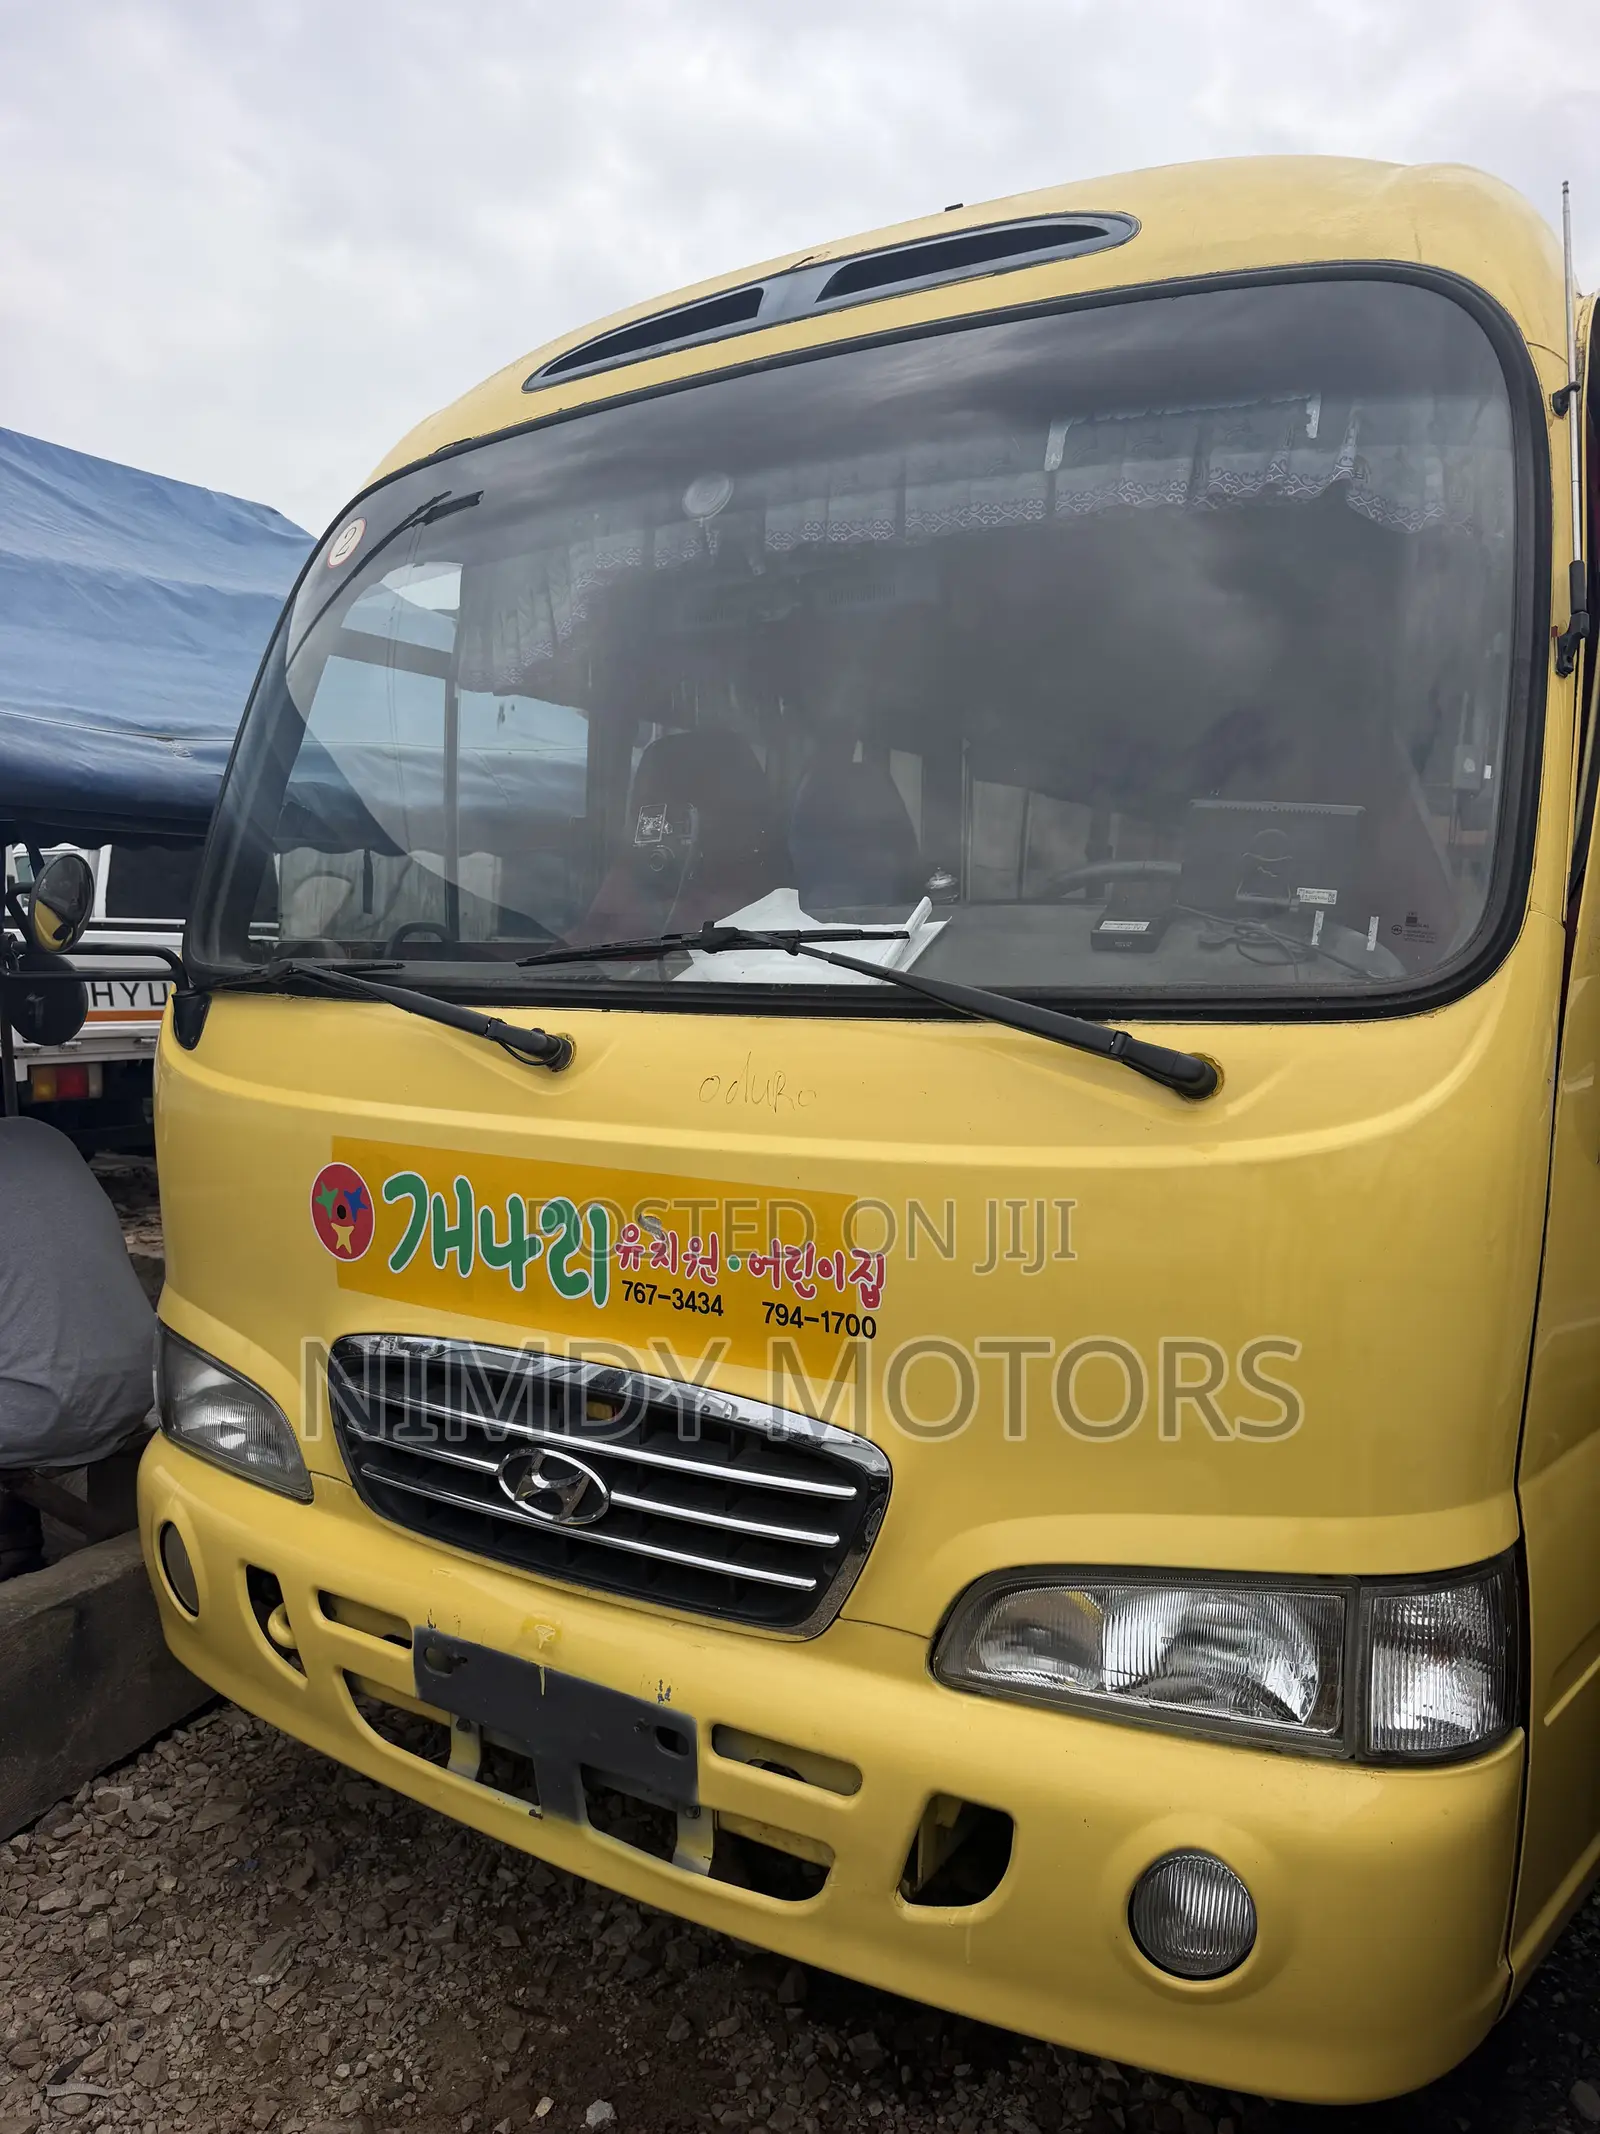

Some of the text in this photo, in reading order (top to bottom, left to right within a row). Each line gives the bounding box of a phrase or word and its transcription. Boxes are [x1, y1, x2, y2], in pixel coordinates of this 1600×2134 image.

[382, 1170, 610, 1308] 개나리
[621, 1279, 877, 1339] 767-3434 794-1700
